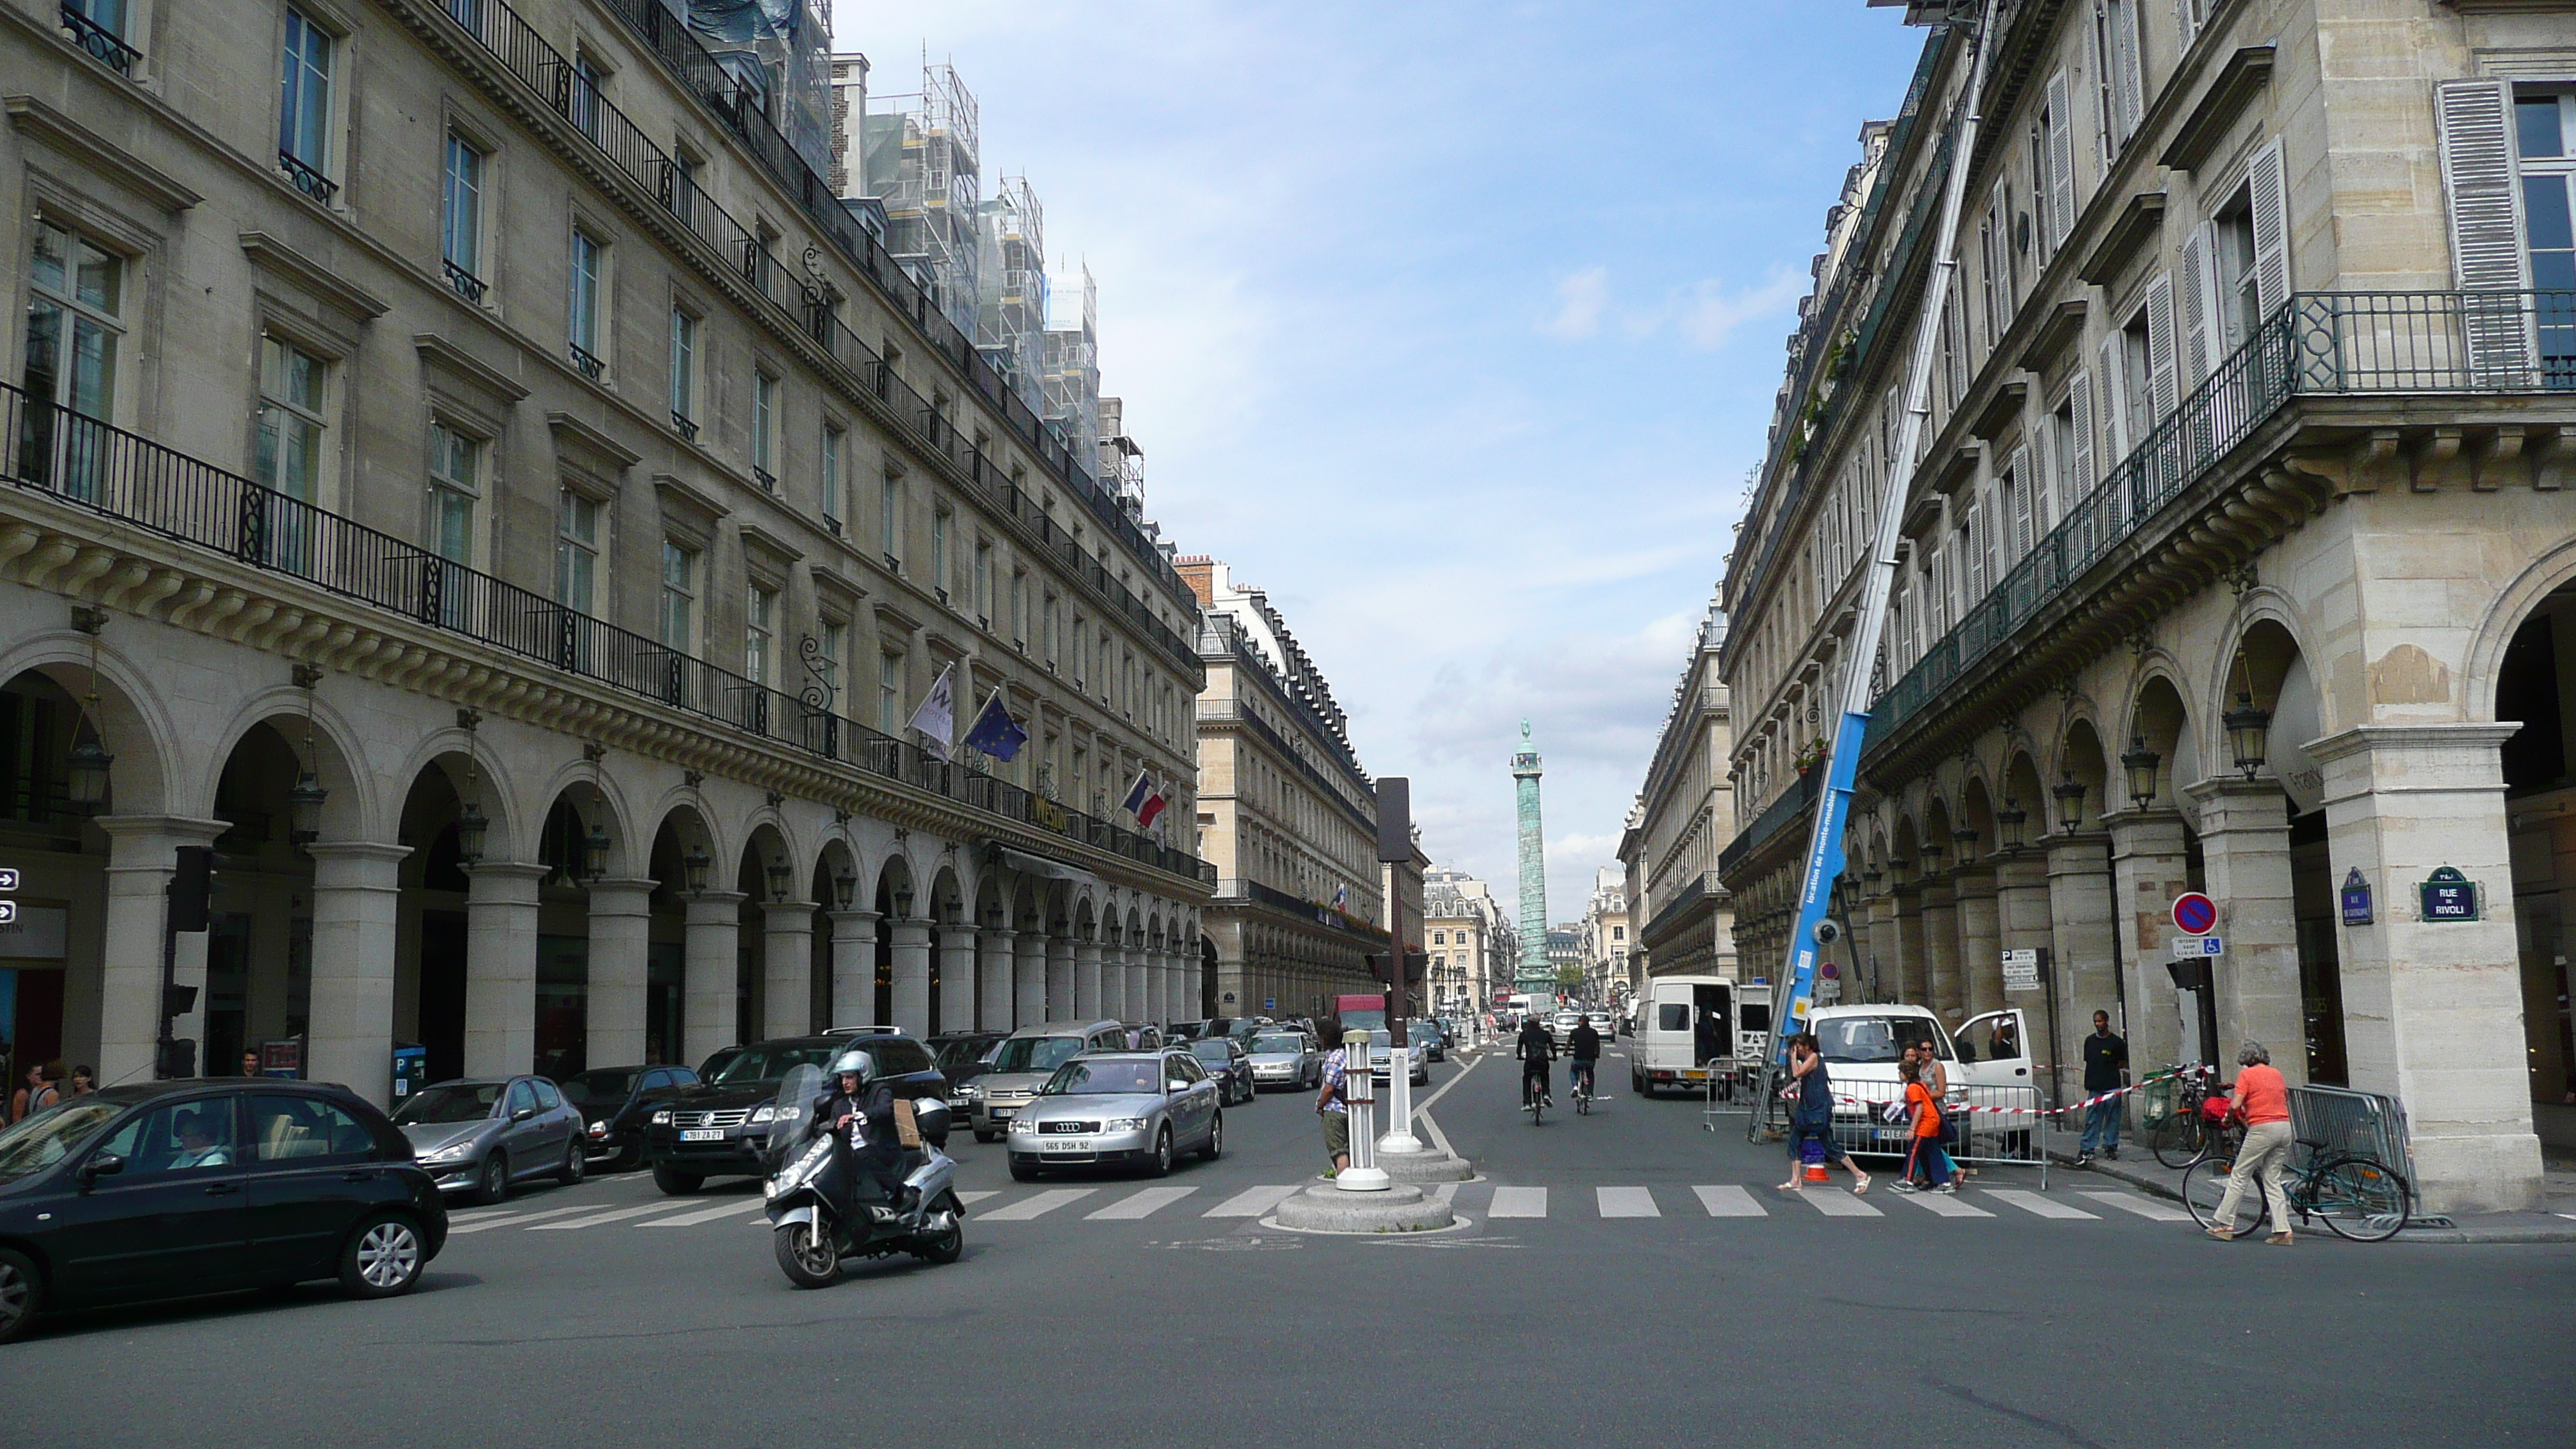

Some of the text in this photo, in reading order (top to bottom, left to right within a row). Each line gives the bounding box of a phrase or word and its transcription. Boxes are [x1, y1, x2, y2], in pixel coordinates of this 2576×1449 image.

[1806, 868, 1821, 904] location
[1814, 855, 1823, 867] de
[2439, 889, 2458, 897] RUE
[2435, 906, 2465, 914] RIVOLI
[2002, 951, 2011, 961] P
[396, 1058, 405, 1071] P
[702, 1131, 711, 1139] ZA
[711, 1130, 721, 1139] 27
[1045, 1141, 1089, 1150] 565 DSH 92
